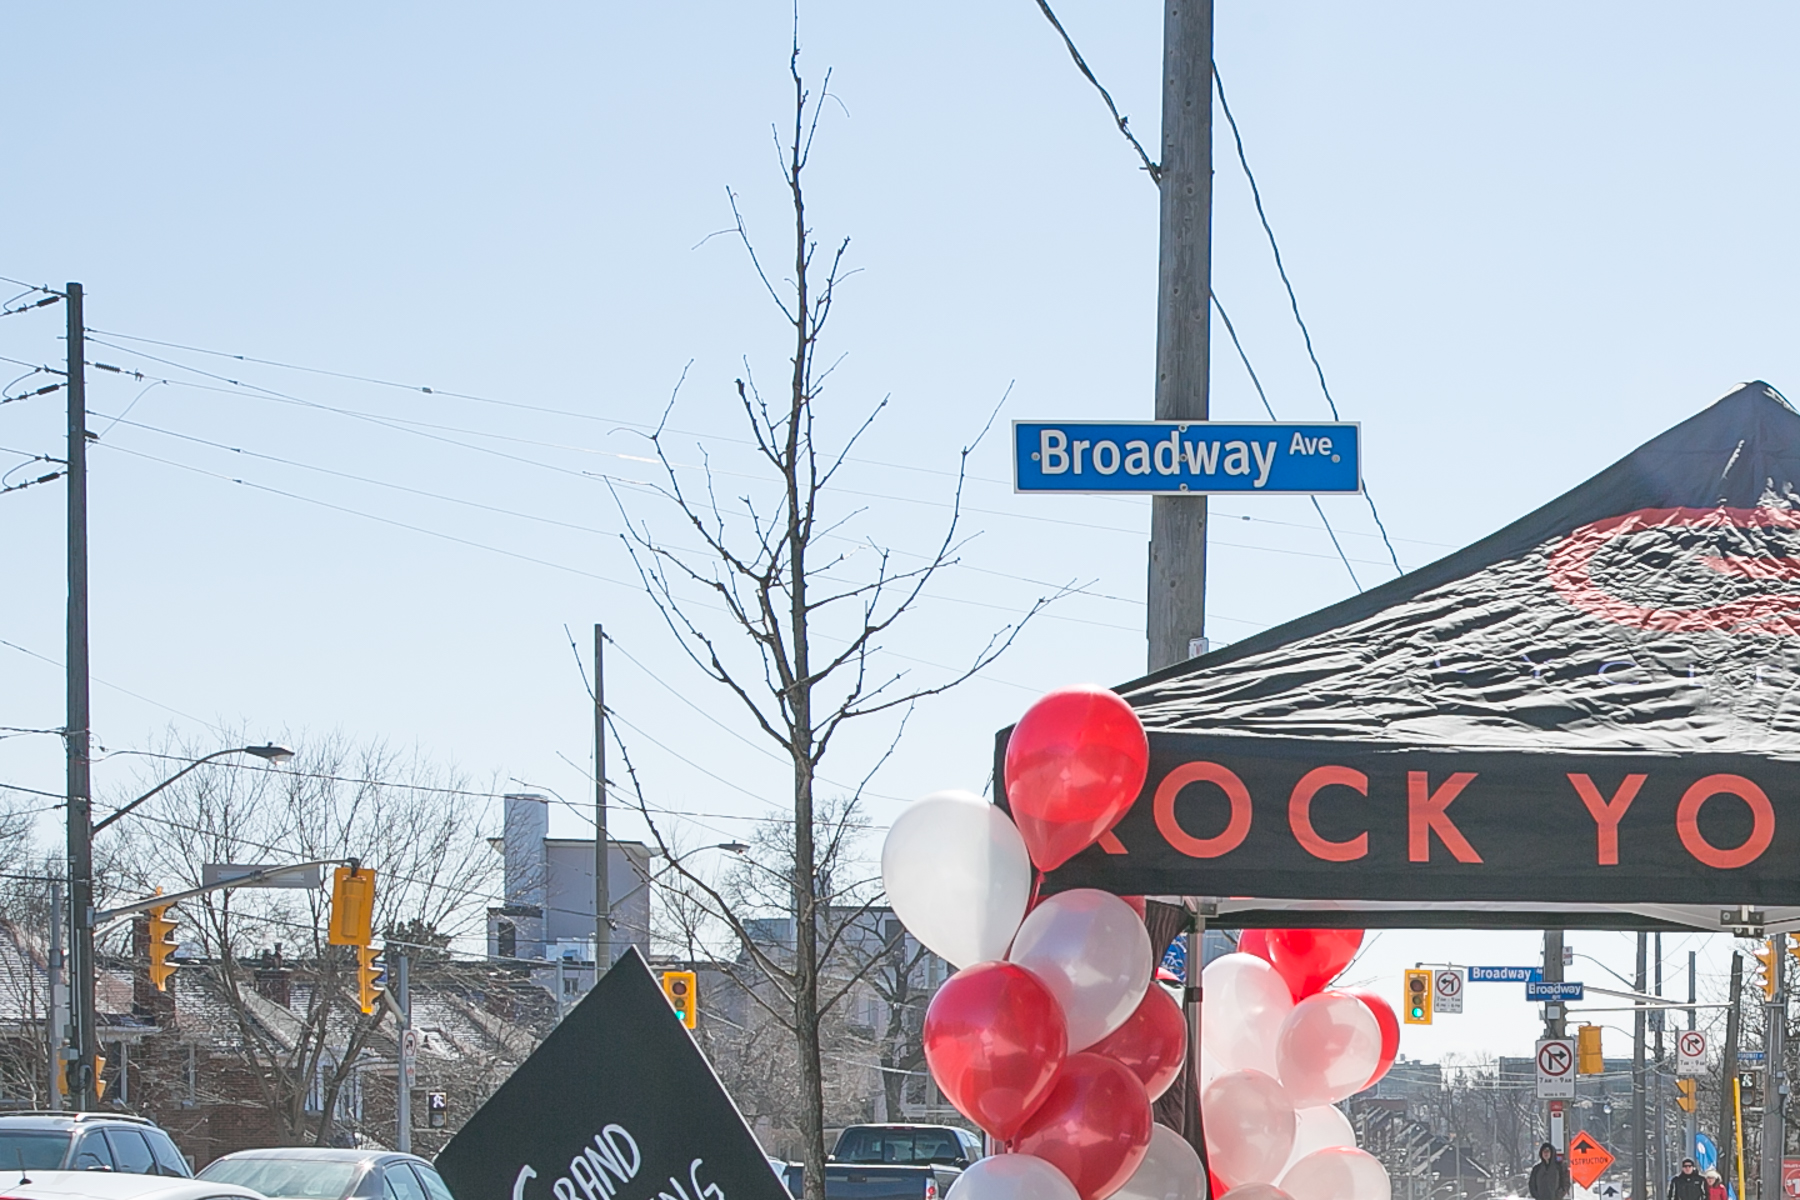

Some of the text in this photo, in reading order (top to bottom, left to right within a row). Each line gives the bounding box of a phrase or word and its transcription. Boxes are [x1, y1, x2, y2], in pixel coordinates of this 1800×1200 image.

[1039, 429, 1333, 489] Broadway Ave
[1096, 761, 1484, 864] OCK
[1472, 967, 1532, 982] Broadway
